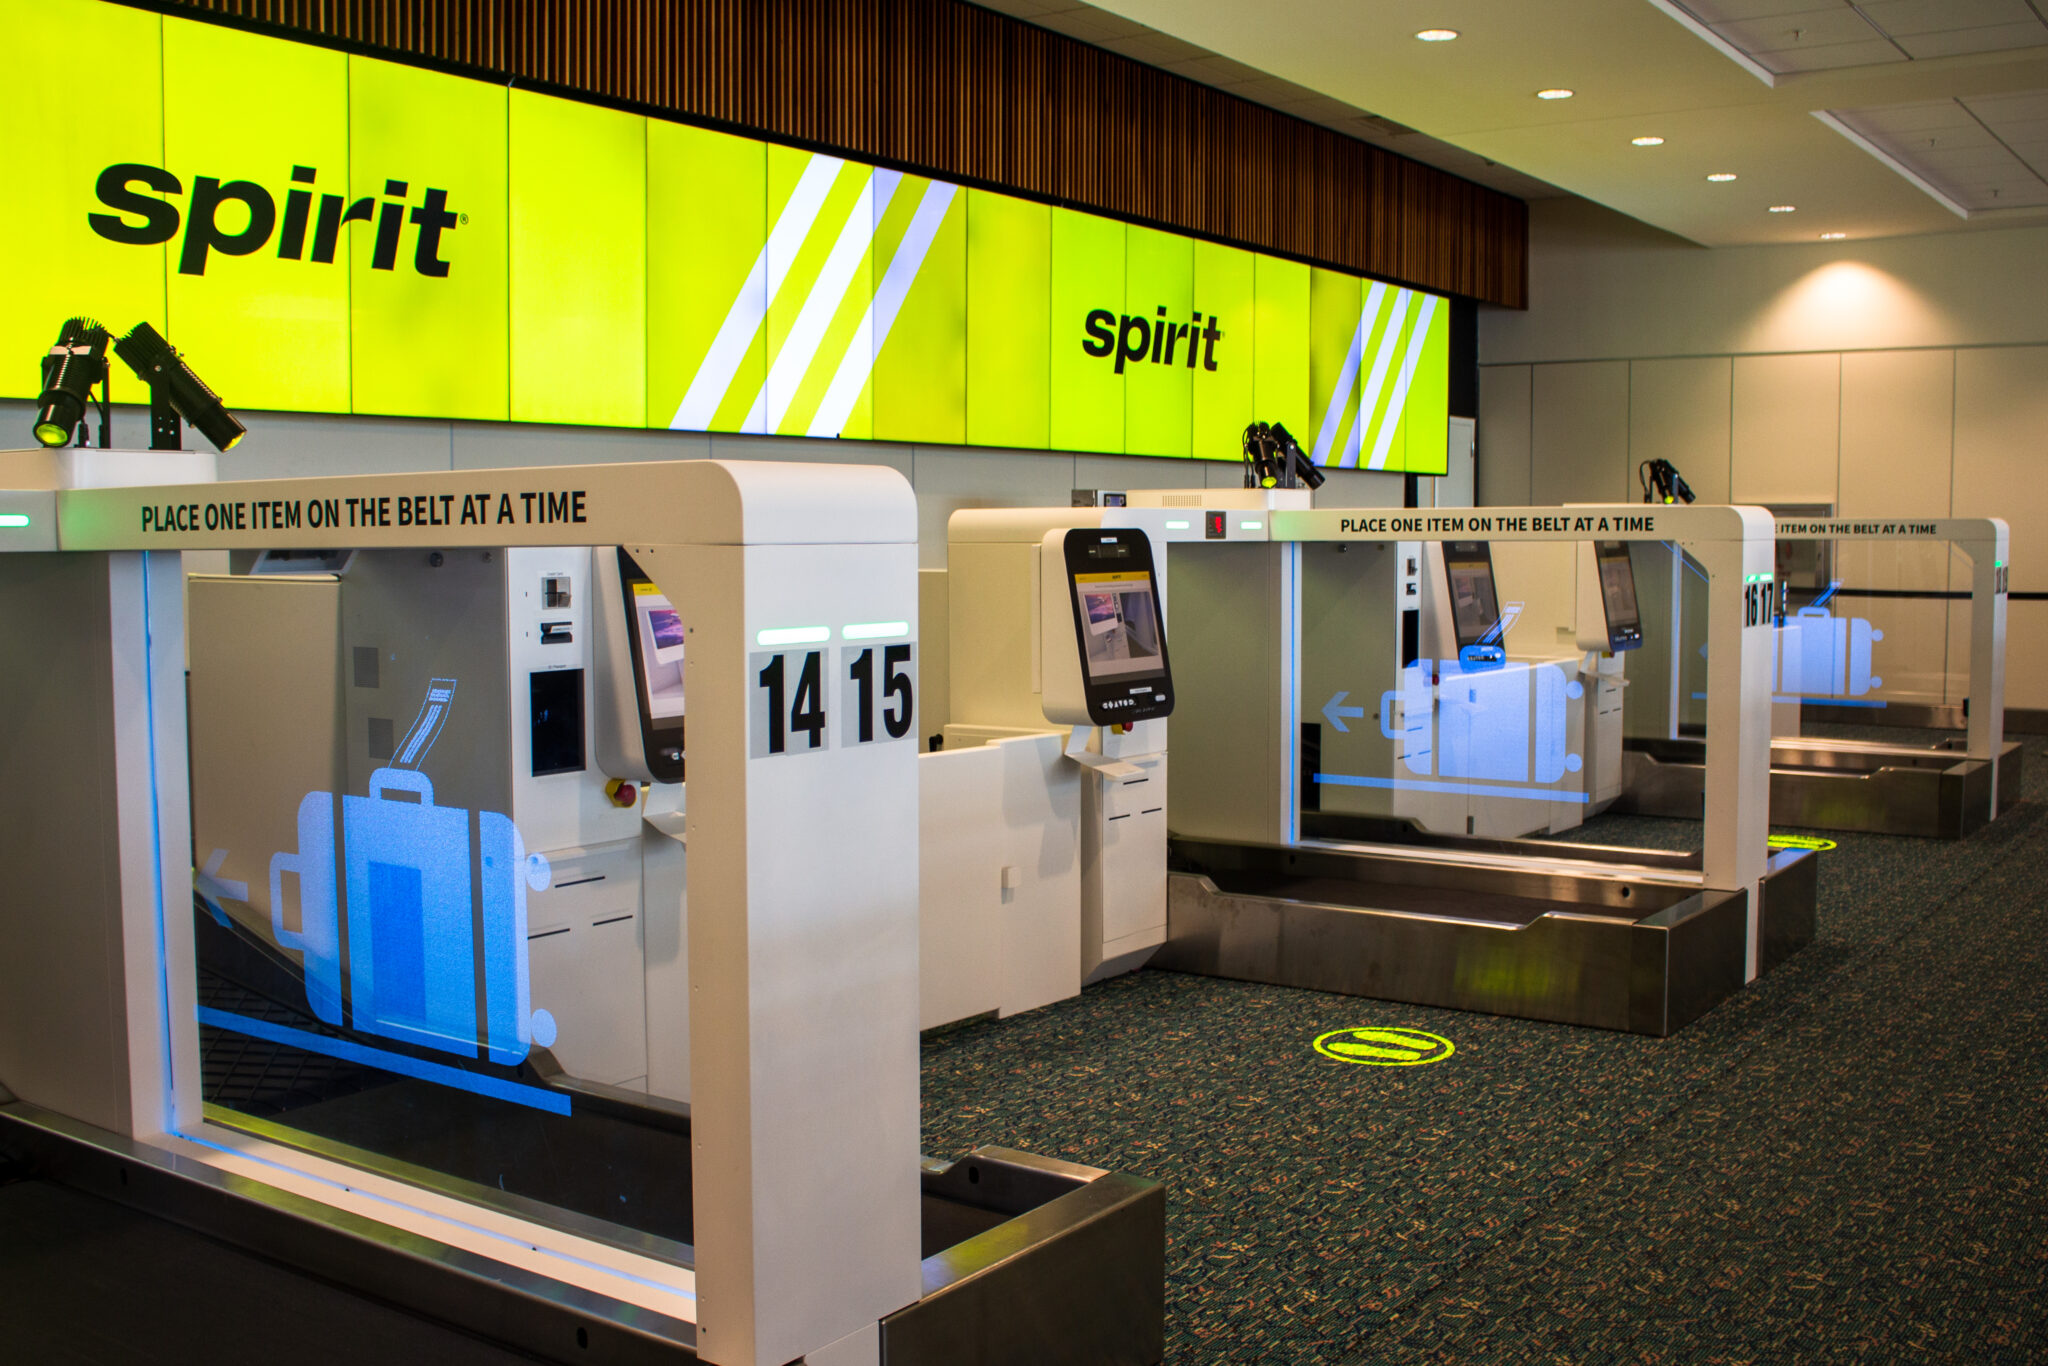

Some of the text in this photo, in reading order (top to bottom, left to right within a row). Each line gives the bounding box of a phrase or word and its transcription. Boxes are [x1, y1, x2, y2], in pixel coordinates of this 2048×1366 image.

[88, 163, 458, 278] spirit
[1082, 305, 1221, 375] spirit
[142, 491, 587, 532] PLACE ONE ITEM ON THE BELT AT A TIME
[1341, 517, 1654, 532] PLACE ONE ITEM ON THE BELT AT A TIME
[1781, 523, 1807, 534] ITEM
[1809, 523, 1826, 534] ON
[1829, 523, 1851, 534] THE
[1854, 524, 1880, 535] BELT
[1882, 524, 1896, 535] AT
[1898, 524, 1906, 535] A
[1909, 524, 1937, 535] TIME
[1745, 582, 1774, 627] 16 17
[759, 644, 914, 754] 14 15
